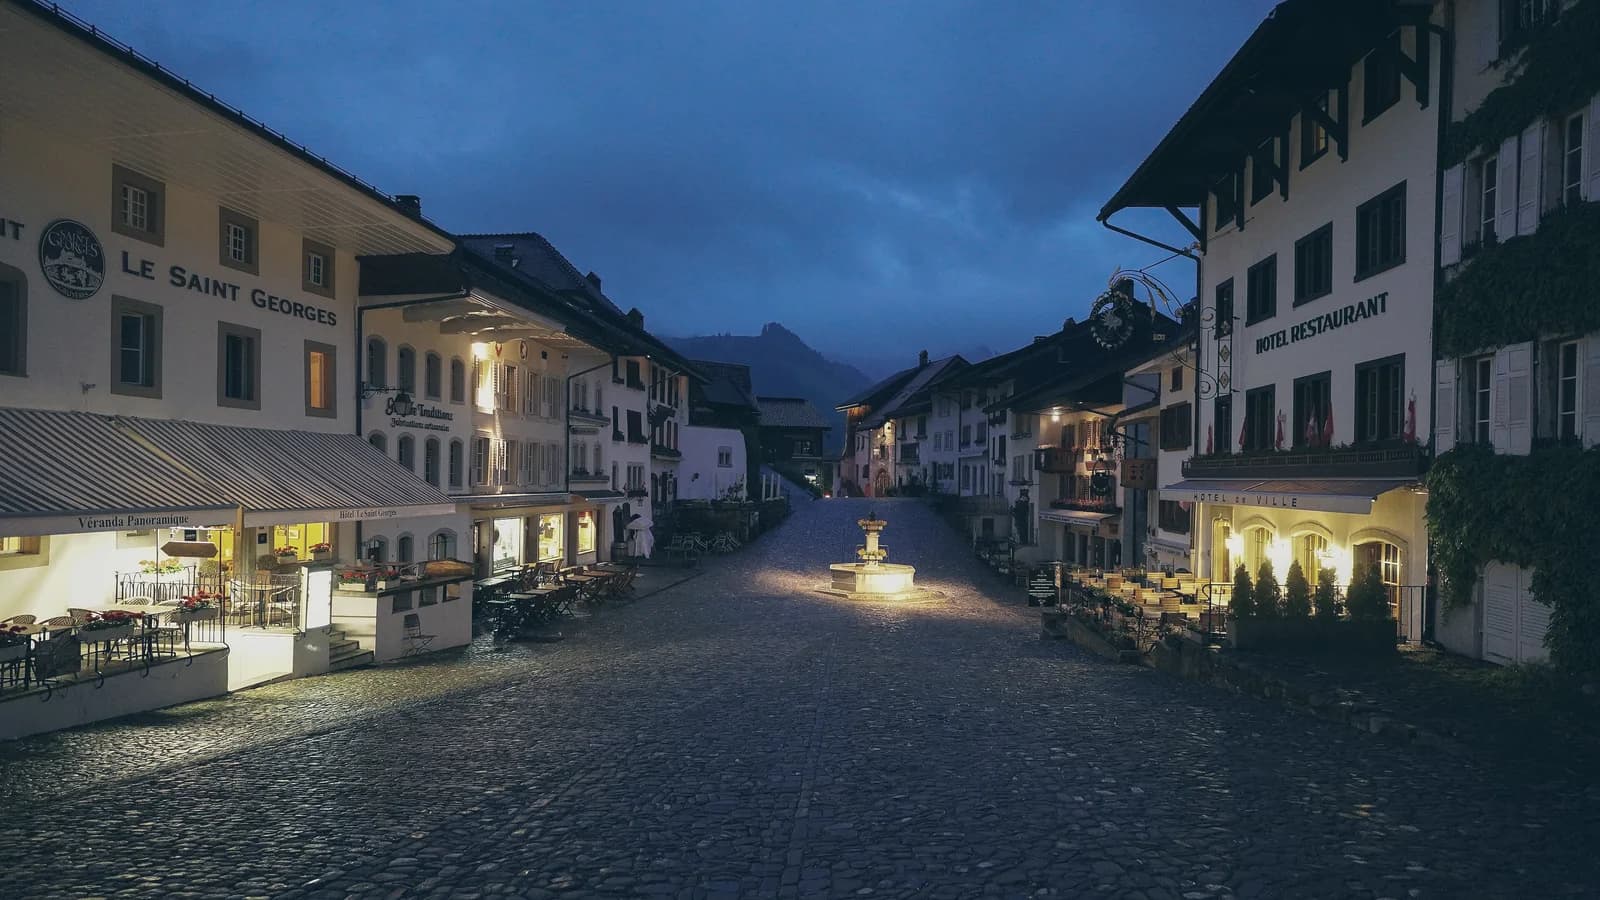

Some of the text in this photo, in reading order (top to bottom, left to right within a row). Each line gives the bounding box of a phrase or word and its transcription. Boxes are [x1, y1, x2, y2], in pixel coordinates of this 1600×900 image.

[122, 251, 337, 326] LE SAINT GEORGES
[1256, 292, 1389, 354] HOTEL RESTAURANT
[1257, 495, 1297, 507] VILLE
[365, 509, 378, 517] Saint
[78, 514, 189, 529] Véranda Panoramique
